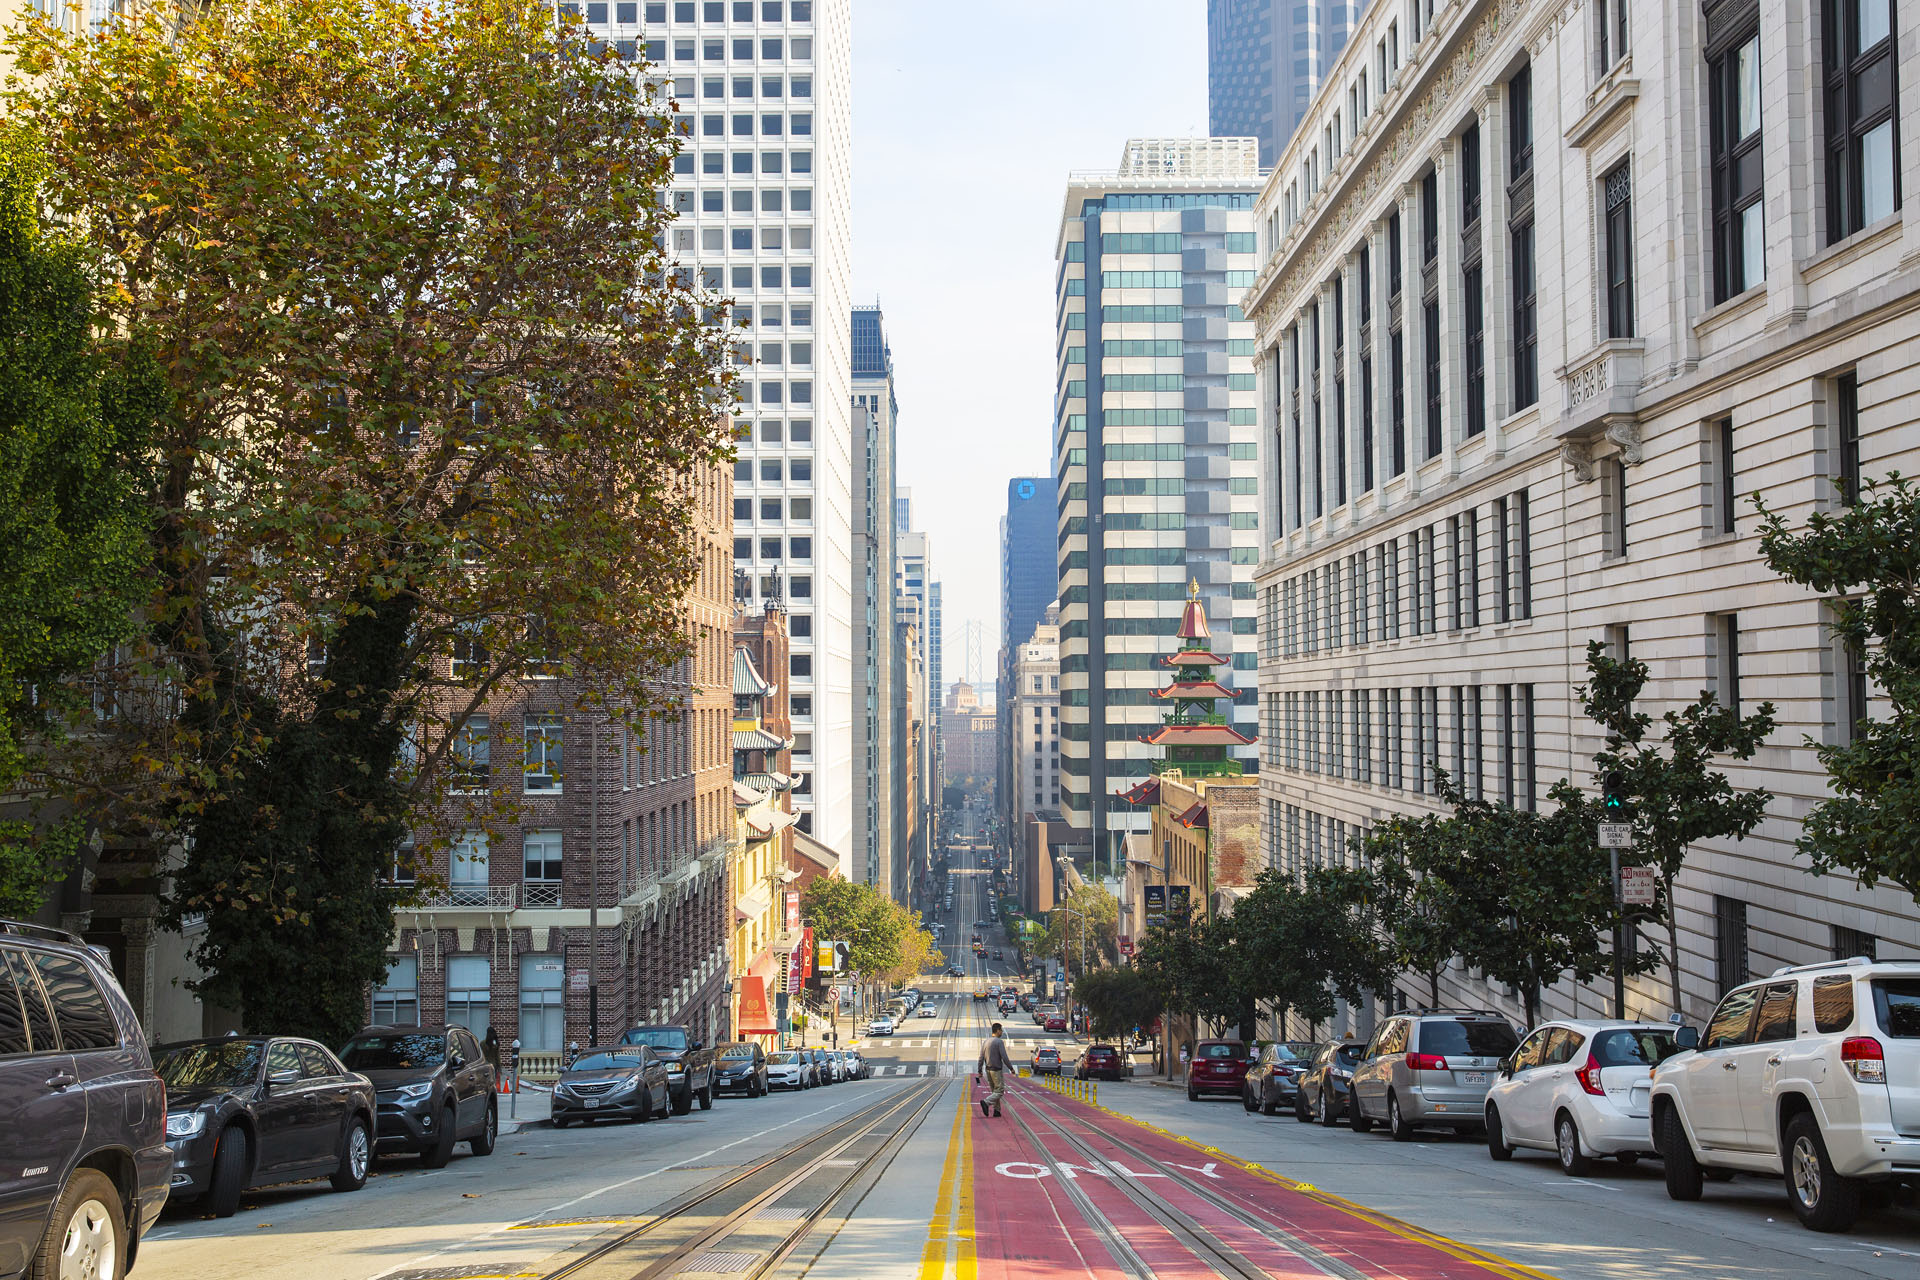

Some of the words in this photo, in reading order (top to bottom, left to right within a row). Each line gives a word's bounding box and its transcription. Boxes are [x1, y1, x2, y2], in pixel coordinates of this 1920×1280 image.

[1622, 868, 1632, 878] NO
[1632, 870, 1653, 878] PARKING
[994, 1160, 1224, 1179] ONLY
